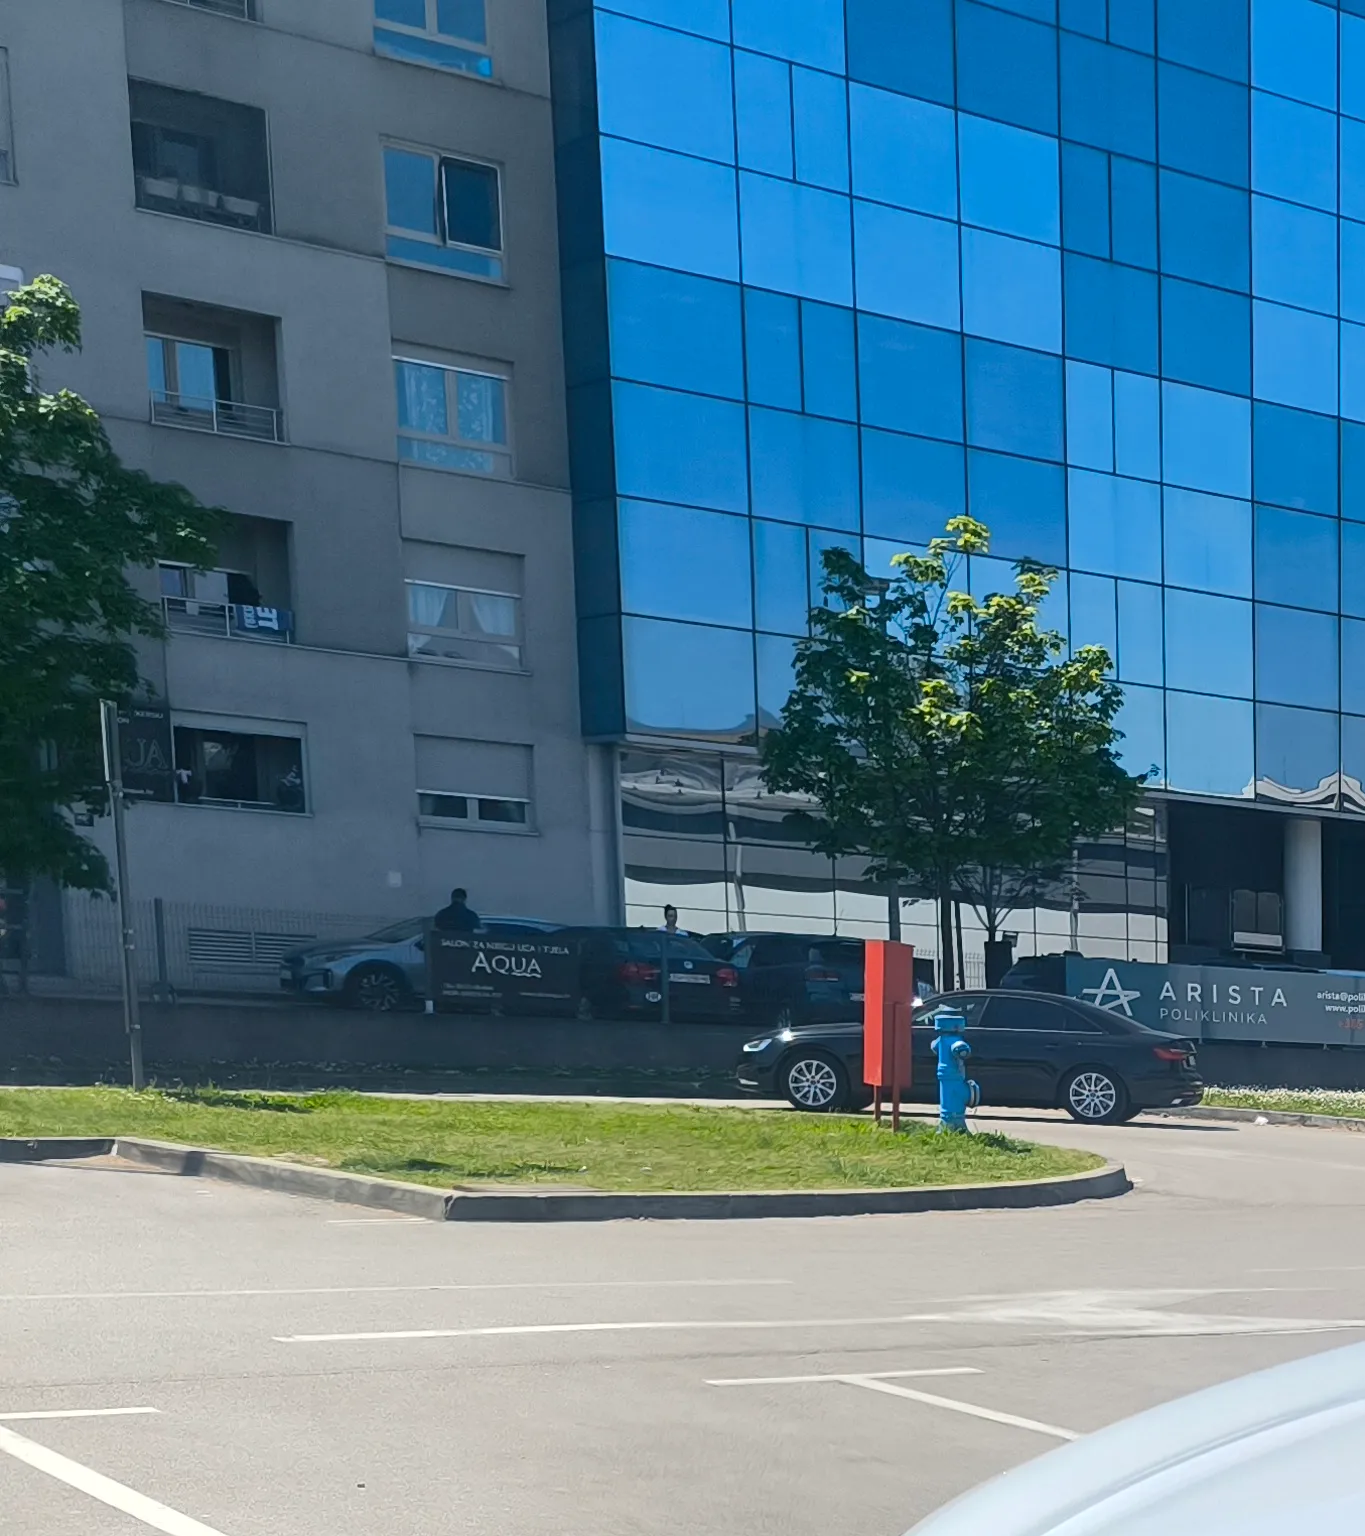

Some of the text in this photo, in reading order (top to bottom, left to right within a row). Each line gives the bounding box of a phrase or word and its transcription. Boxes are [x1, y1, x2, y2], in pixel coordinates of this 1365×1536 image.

[471, 951, 542, 975] AQUA
[1159, 981, 1288, 1007] ARISTA
[1159, 1008, 1268, 1025] POLIKLINIKA
